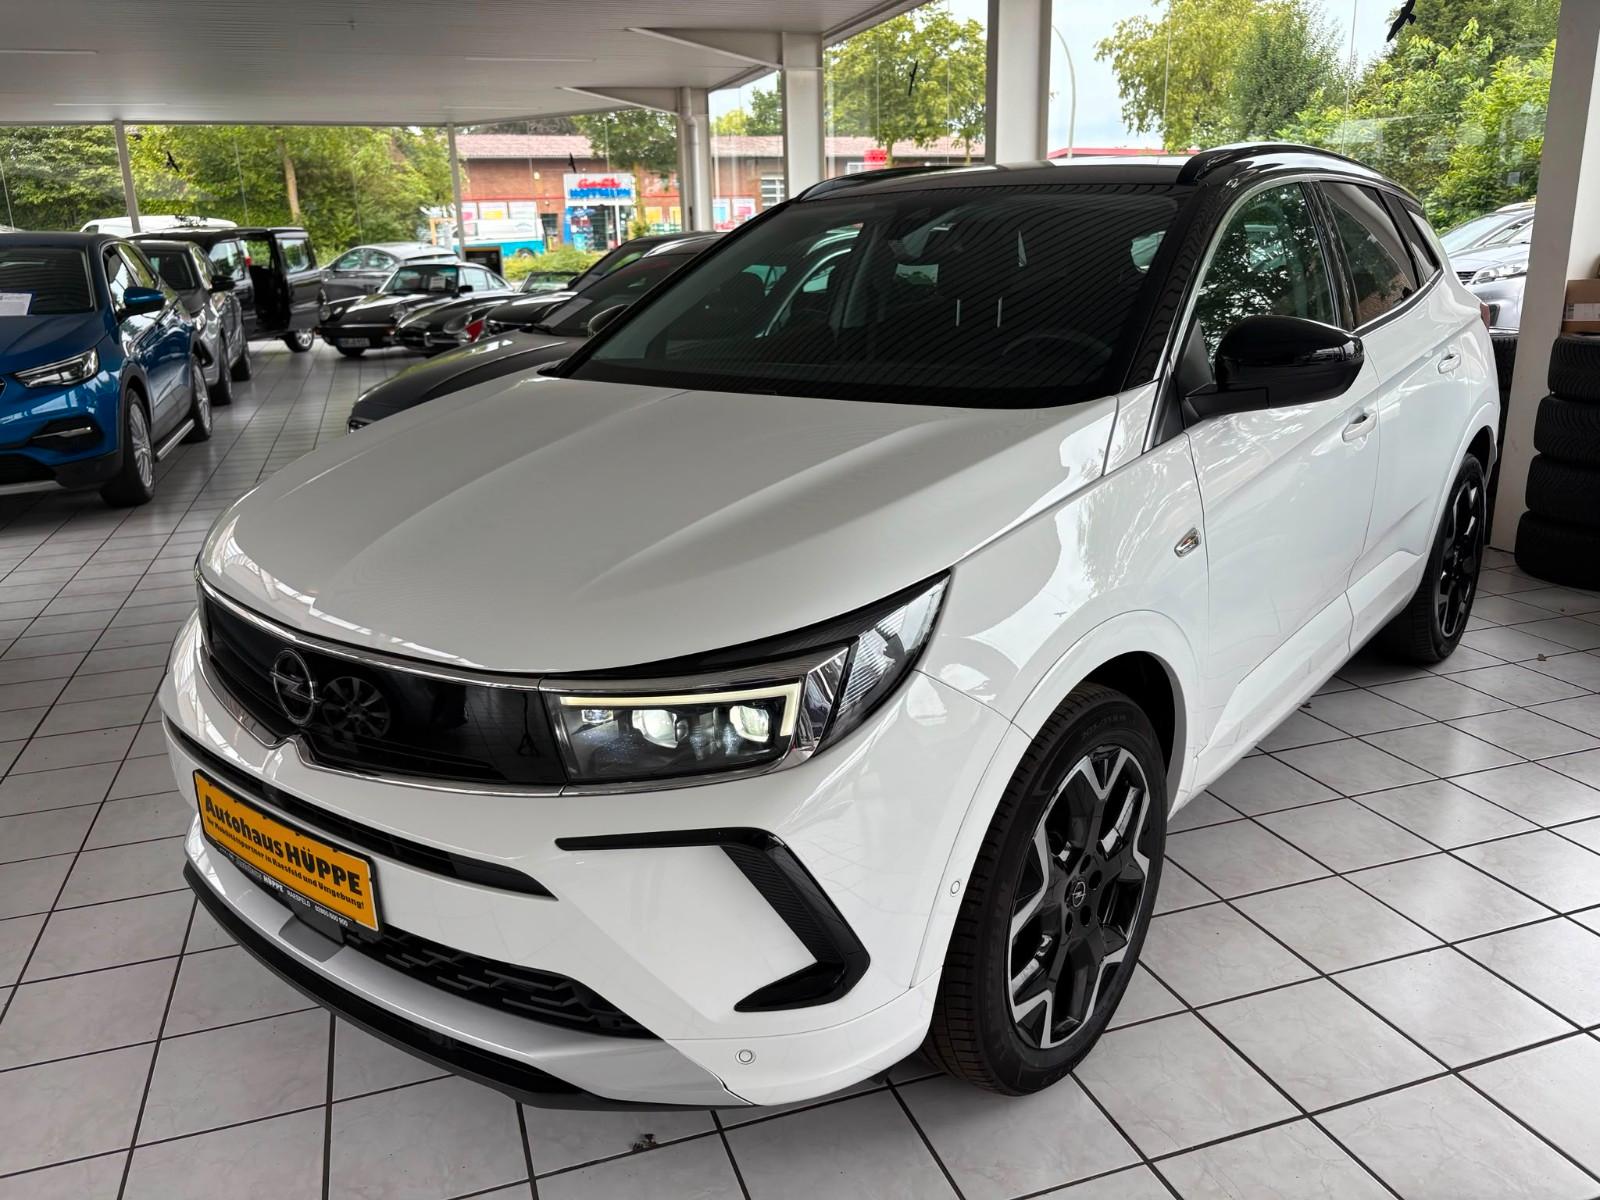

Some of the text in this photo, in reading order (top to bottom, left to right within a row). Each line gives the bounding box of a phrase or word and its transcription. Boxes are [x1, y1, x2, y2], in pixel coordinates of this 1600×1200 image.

[205, 794, 363, 896] Autohaus HÜPPE
[302, 875, 317, 888] und
[317, 880, 365, 910] Umgebung!
